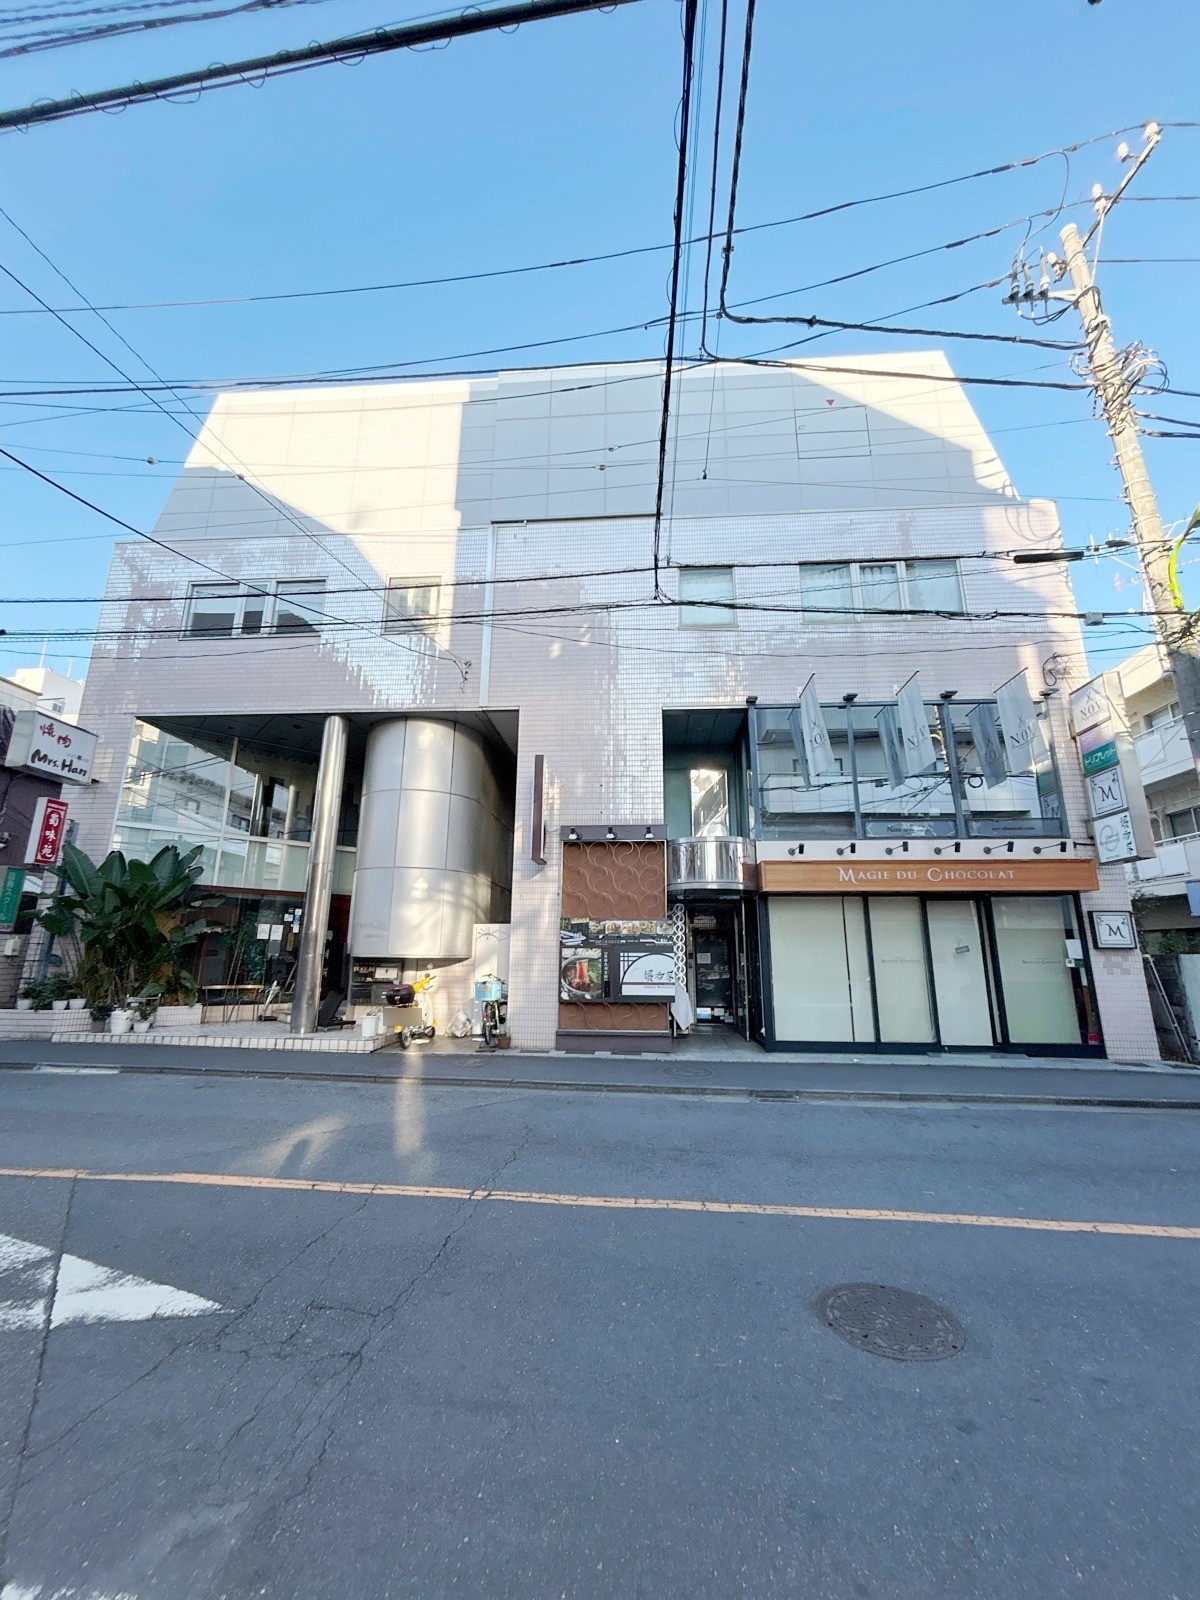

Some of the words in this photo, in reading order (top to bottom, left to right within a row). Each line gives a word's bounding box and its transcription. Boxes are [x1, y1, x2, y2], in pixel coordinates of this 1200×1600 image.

[40, 722, 72, 748] 焼肉
[61, 758, 88, 777] Han
[1098, 786, 1118, 802] M
[1105, 923, 1126, 939] M
